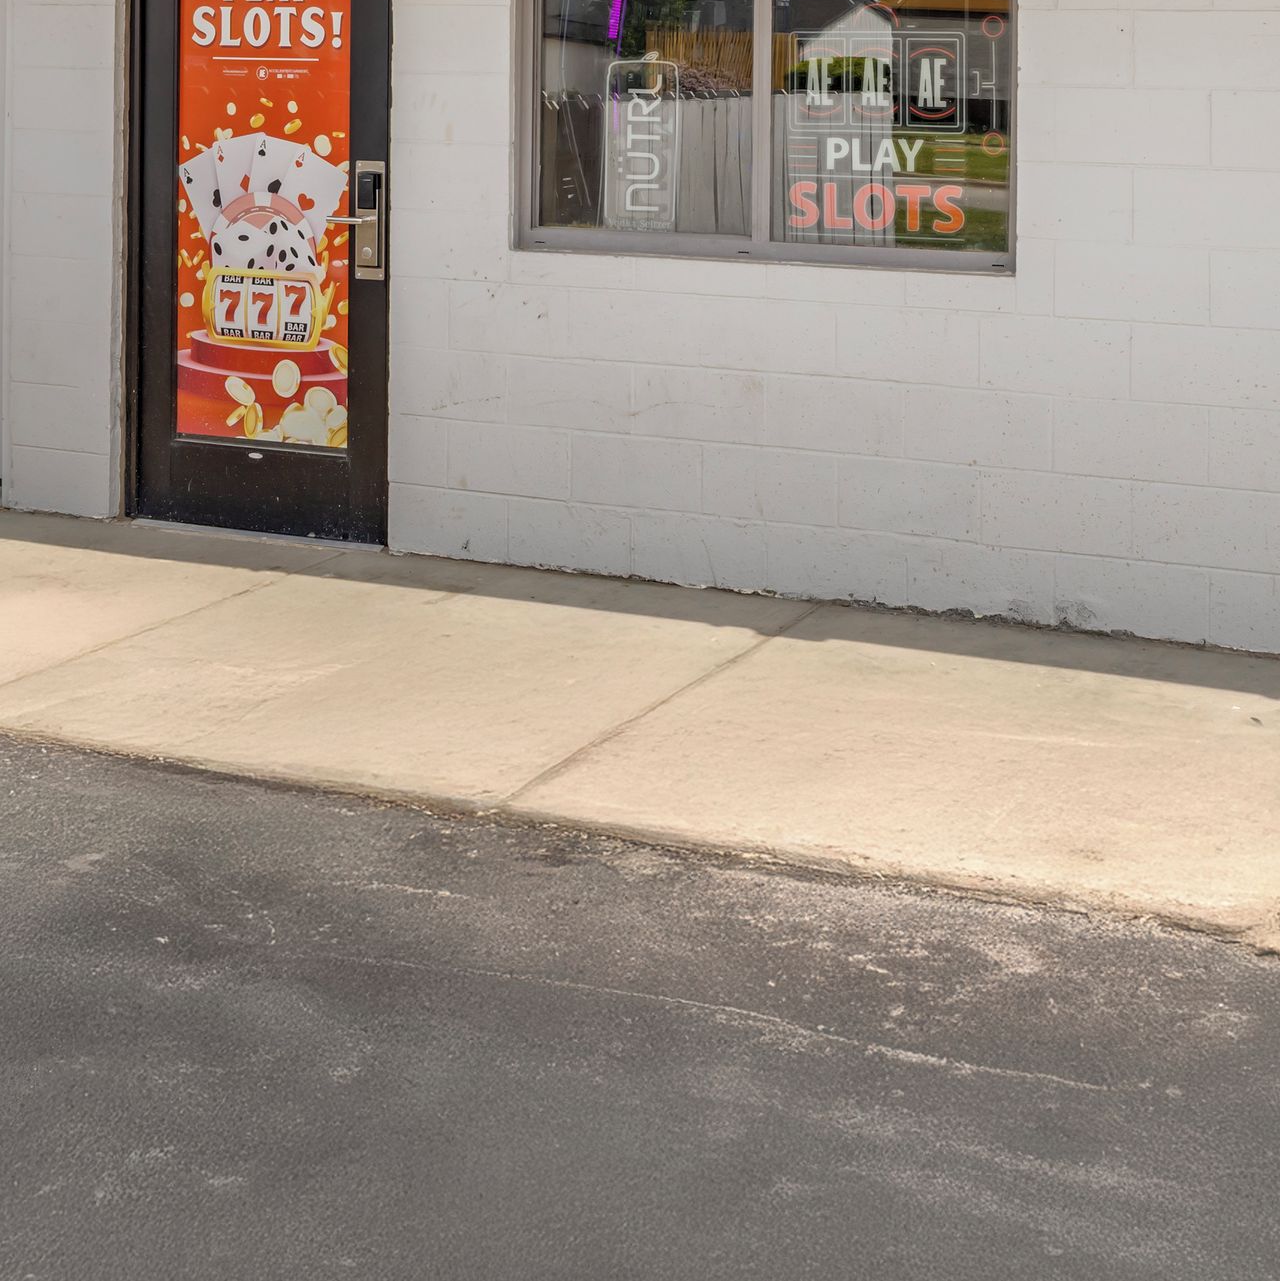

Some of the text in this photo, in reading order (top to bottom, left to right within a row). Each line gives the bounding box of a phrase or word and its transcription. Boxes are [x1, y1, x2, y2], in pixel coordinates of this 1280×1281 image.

[191, 5, 344, 49] SLOTS!
[806, 57, 947, 108] AE AE AE
[826, 137, 924, 172] PLAY
[788, 181, 966, 234] SLOTS
[224, 275, 272, 285] BAR BAR
[219, 285, 306, 325] 7 7 7
[224, 328, 303, 342] BAR BAR BAR
[287, 323, 305, 332] BAR
